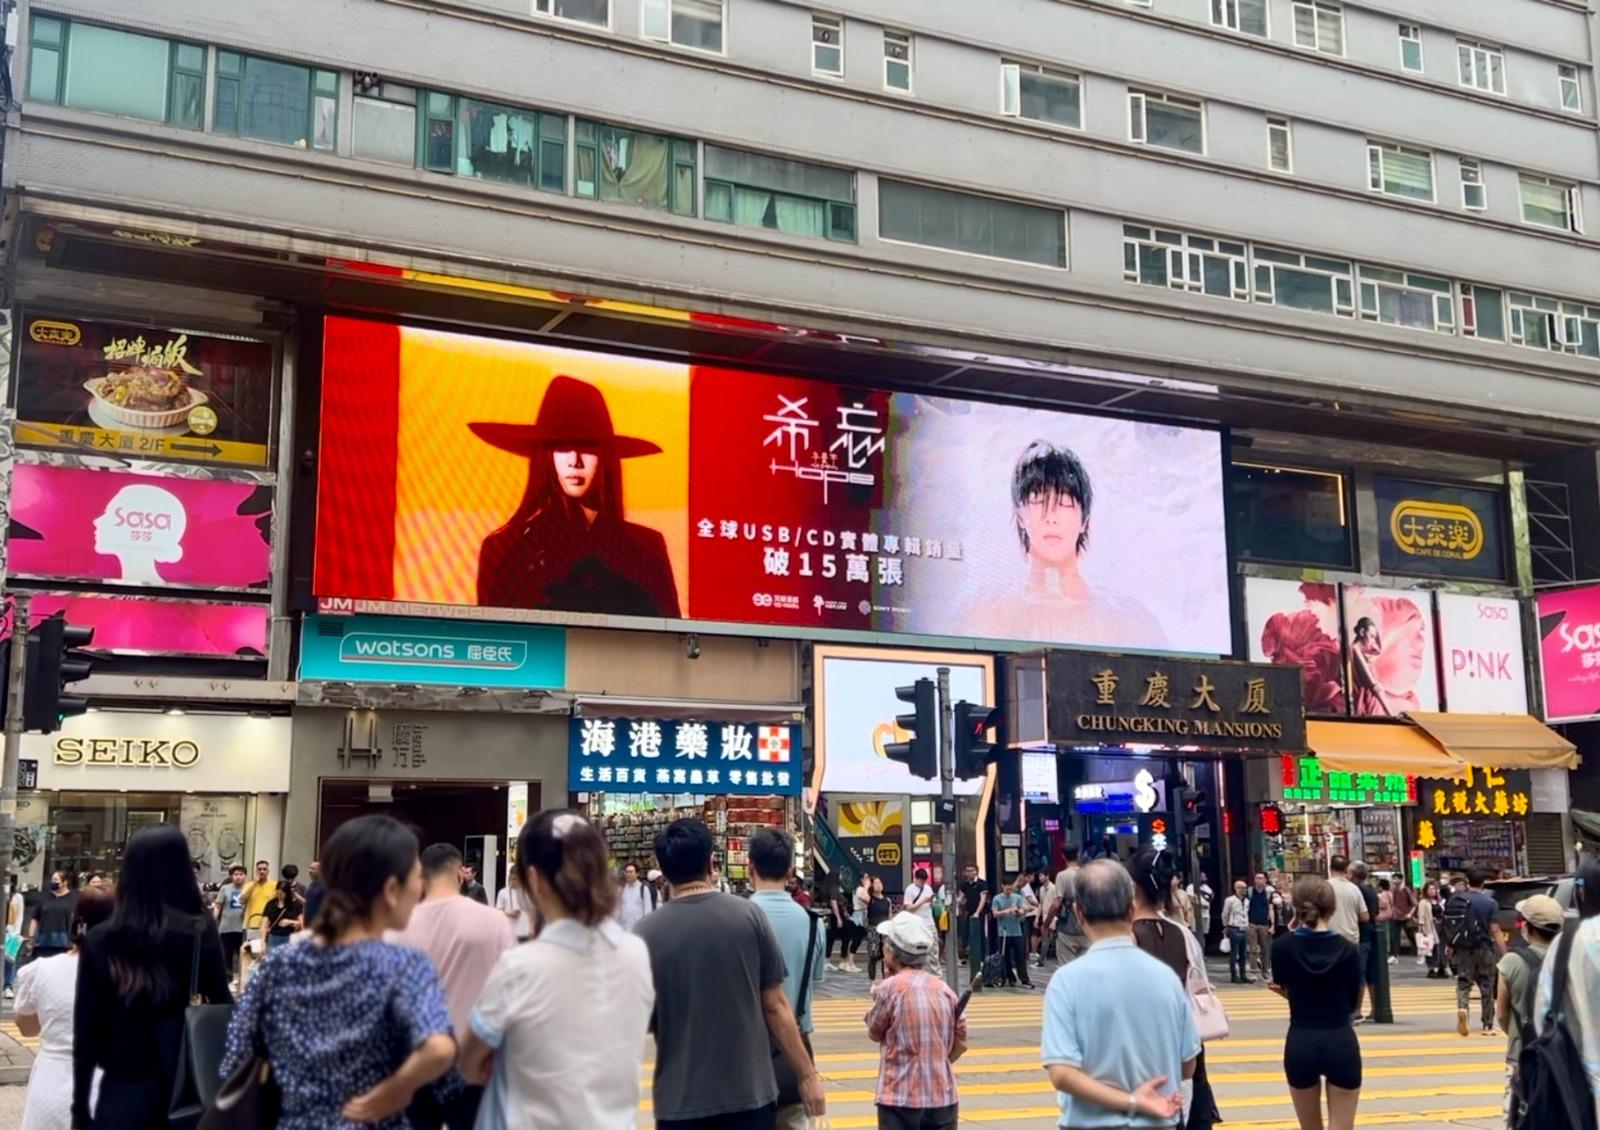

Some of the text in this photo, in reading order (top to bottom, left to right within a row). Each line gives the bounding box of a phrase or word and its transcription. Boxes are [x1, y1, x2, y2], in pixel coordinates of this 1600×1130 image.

[139, 435, 166, 452] 2/F
[763, 547, 904, 586] 破15萬張
[320, 597, 352, 611] JM
[355, 600, 386, 614] JM
[355, 640, 455, 659] watsons
[467, 644, 512, 662] 屈臣氏
[1451, 649, 1513, 680] P!NK
[1076, 714, 1283, 739] CHUNGKING MANSIONS
[580, 719, 753, 761] 海港藥妝
[55, 737, 200, 767] SEIKO
[580, 767, 647, 783] 生活百貨
